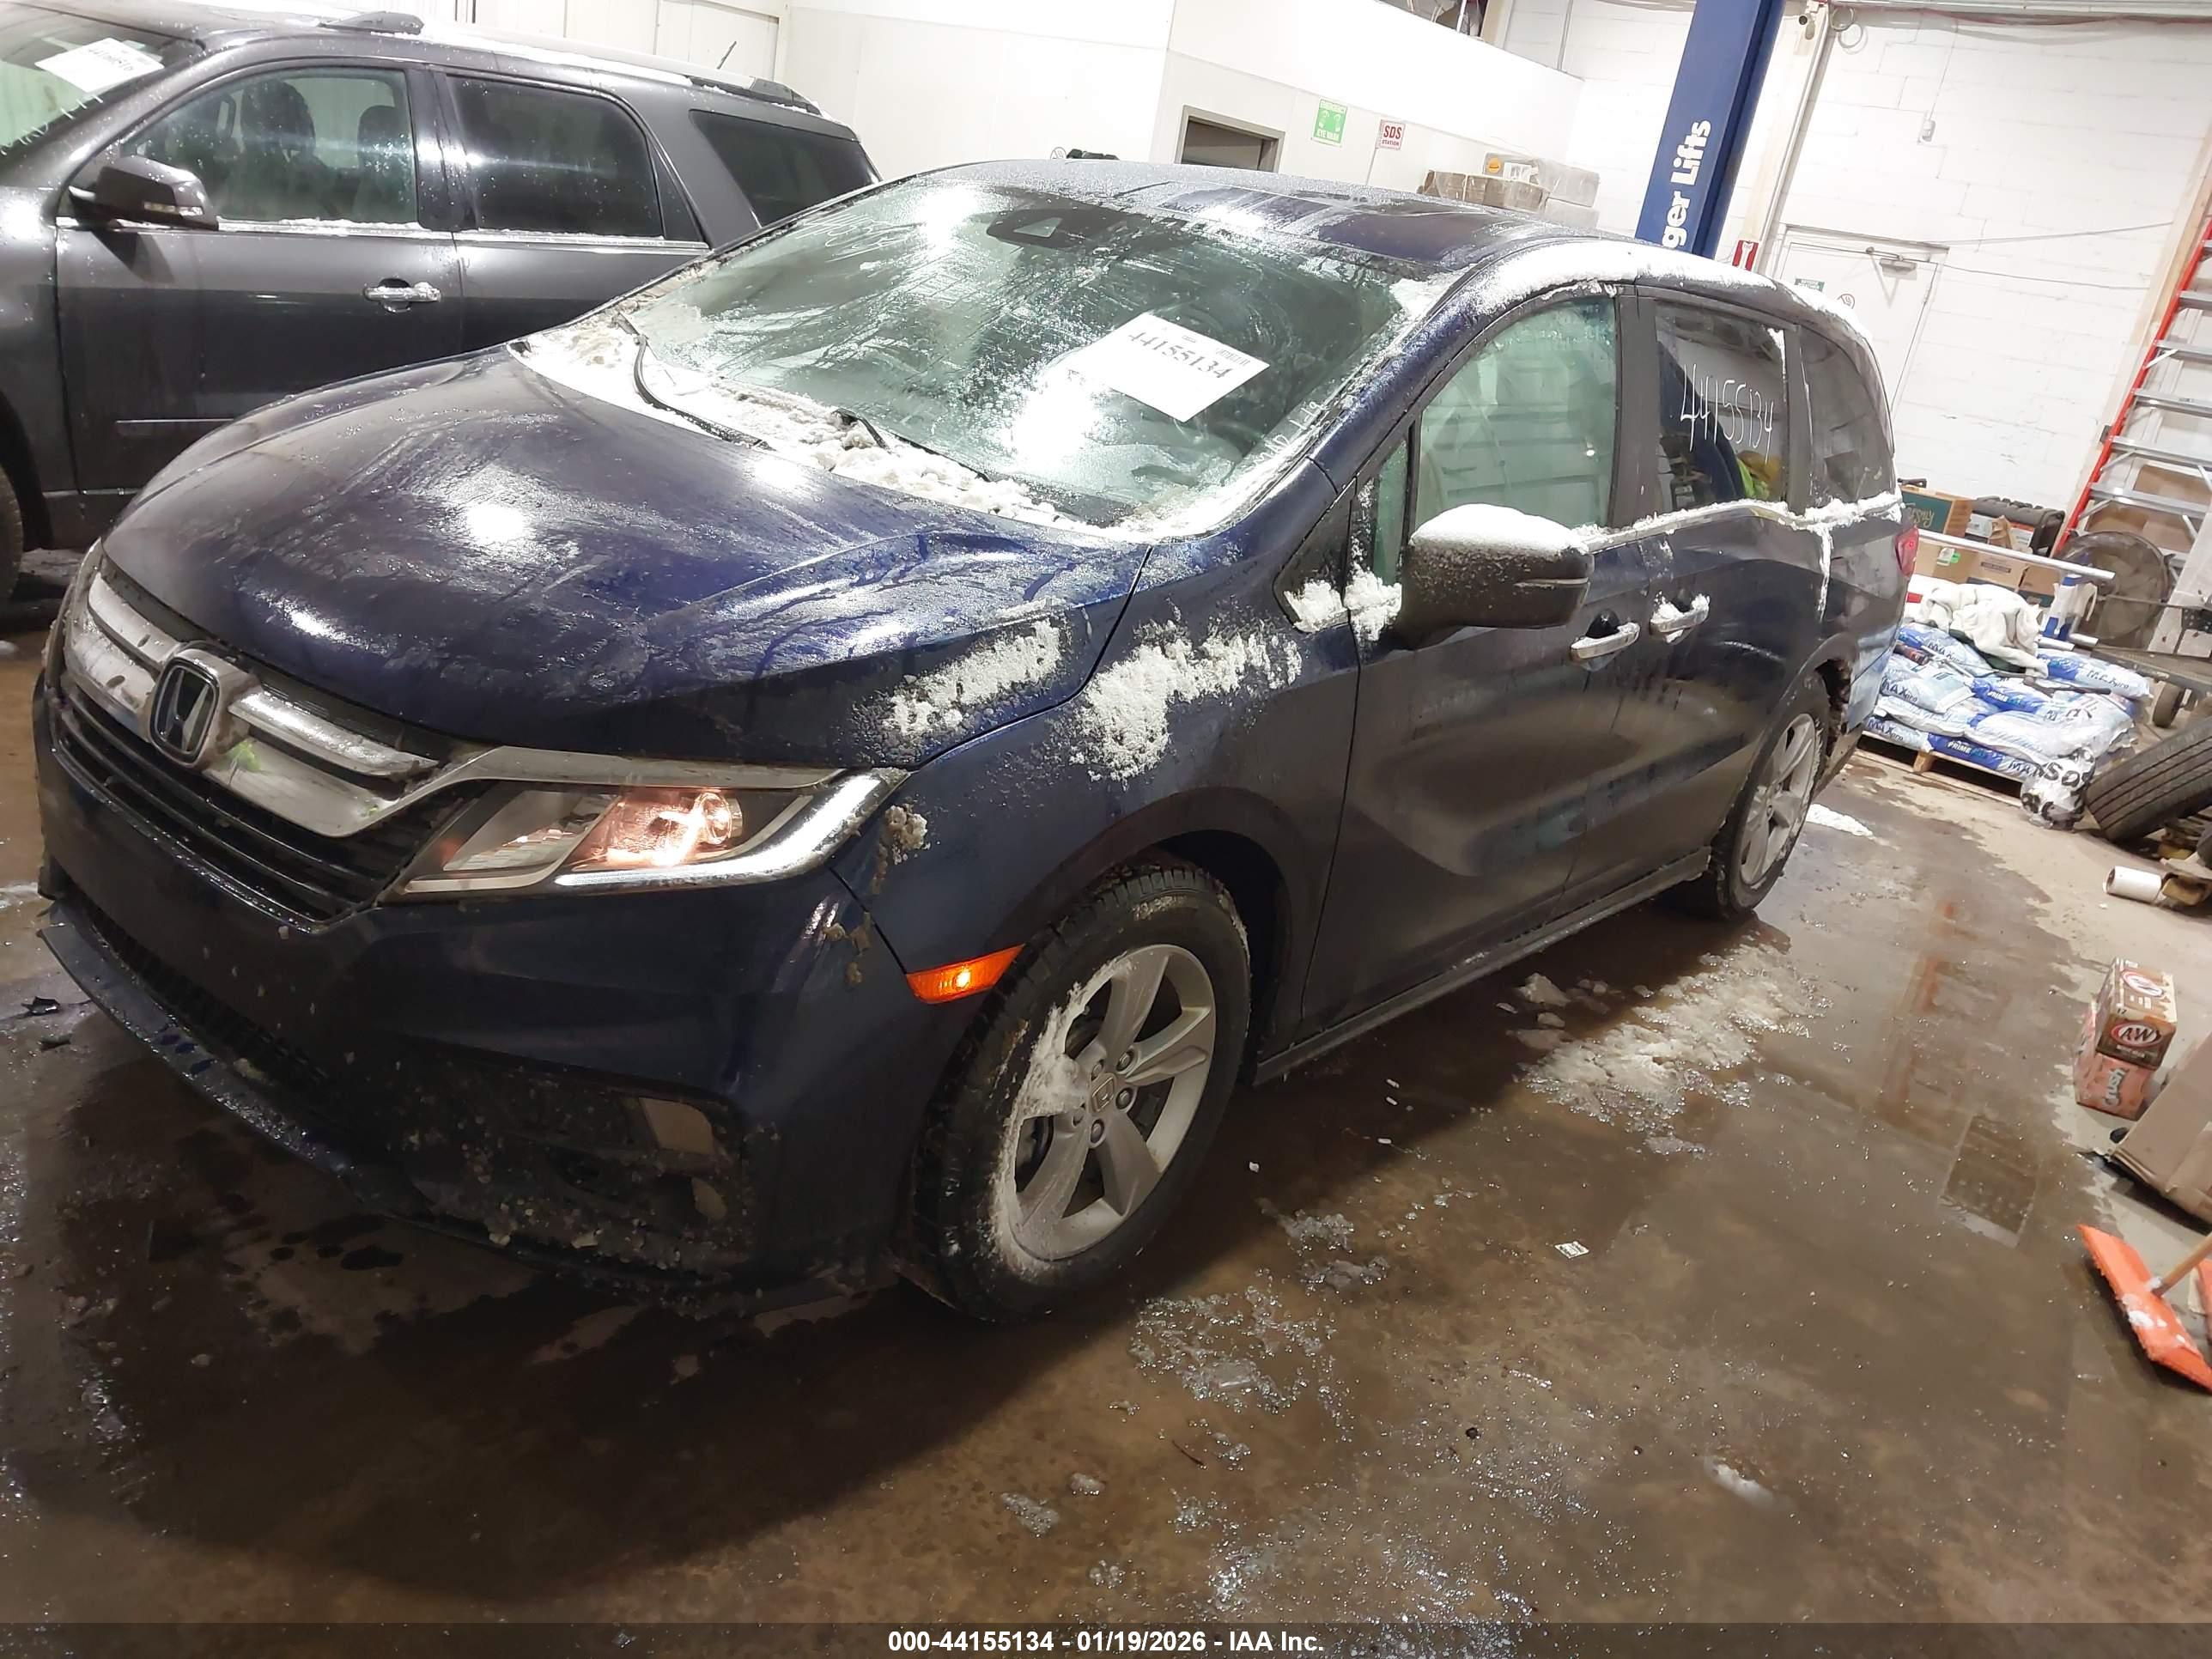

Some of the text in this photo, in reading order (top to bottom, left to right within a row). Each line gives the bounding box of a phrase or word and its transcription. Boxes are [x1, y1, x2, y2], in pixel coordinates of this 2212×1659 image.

[1383, 125, 1402, 140] SDS
[1670, 120, 1711, 185] Lifts
[1128, 331, 1234, 379] 44155134
[1947, 740, 1972, 754] PRIME
